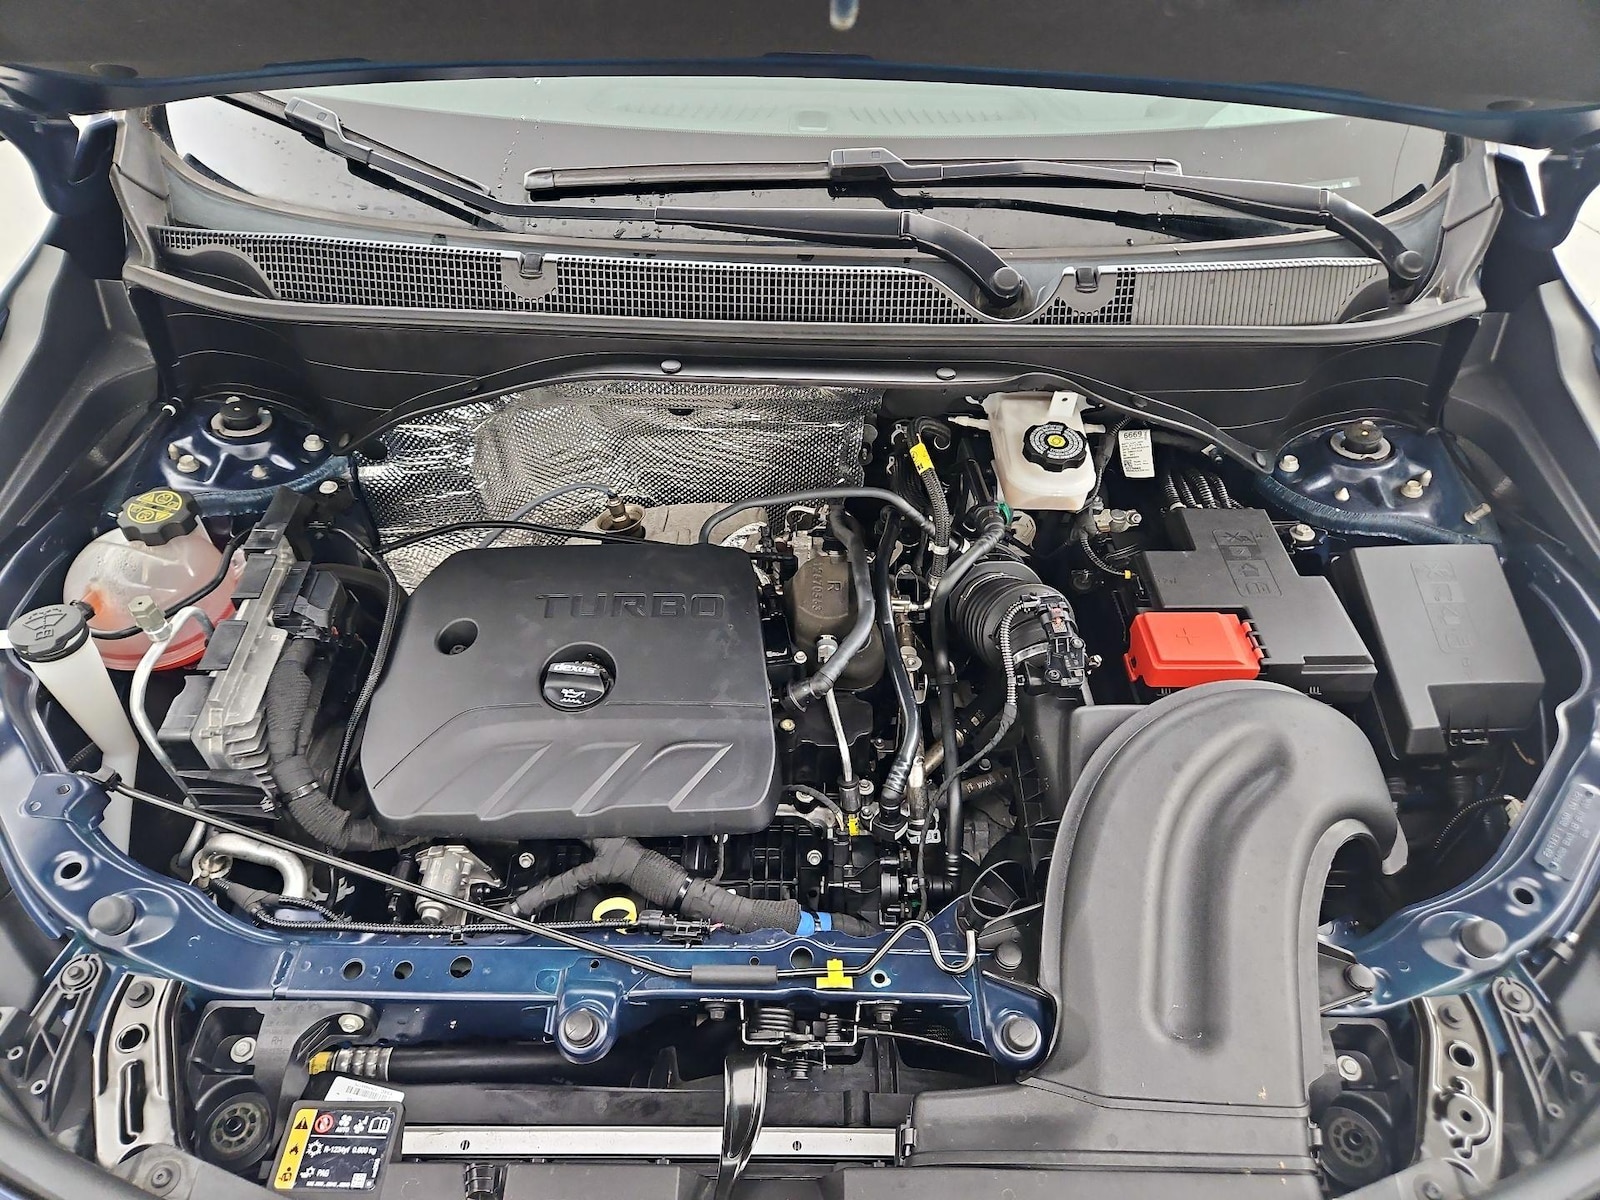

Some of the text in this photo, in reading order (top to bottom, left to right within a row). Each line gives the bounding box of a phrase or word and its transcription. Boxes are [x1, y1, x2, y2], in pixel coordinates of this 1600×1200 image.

[827, 580, 842, 591] R
[535, 592, 725, 619] TURBO
[554, 662, 596, 674] dexos
[316, 1168, 330, 1177] PAG
